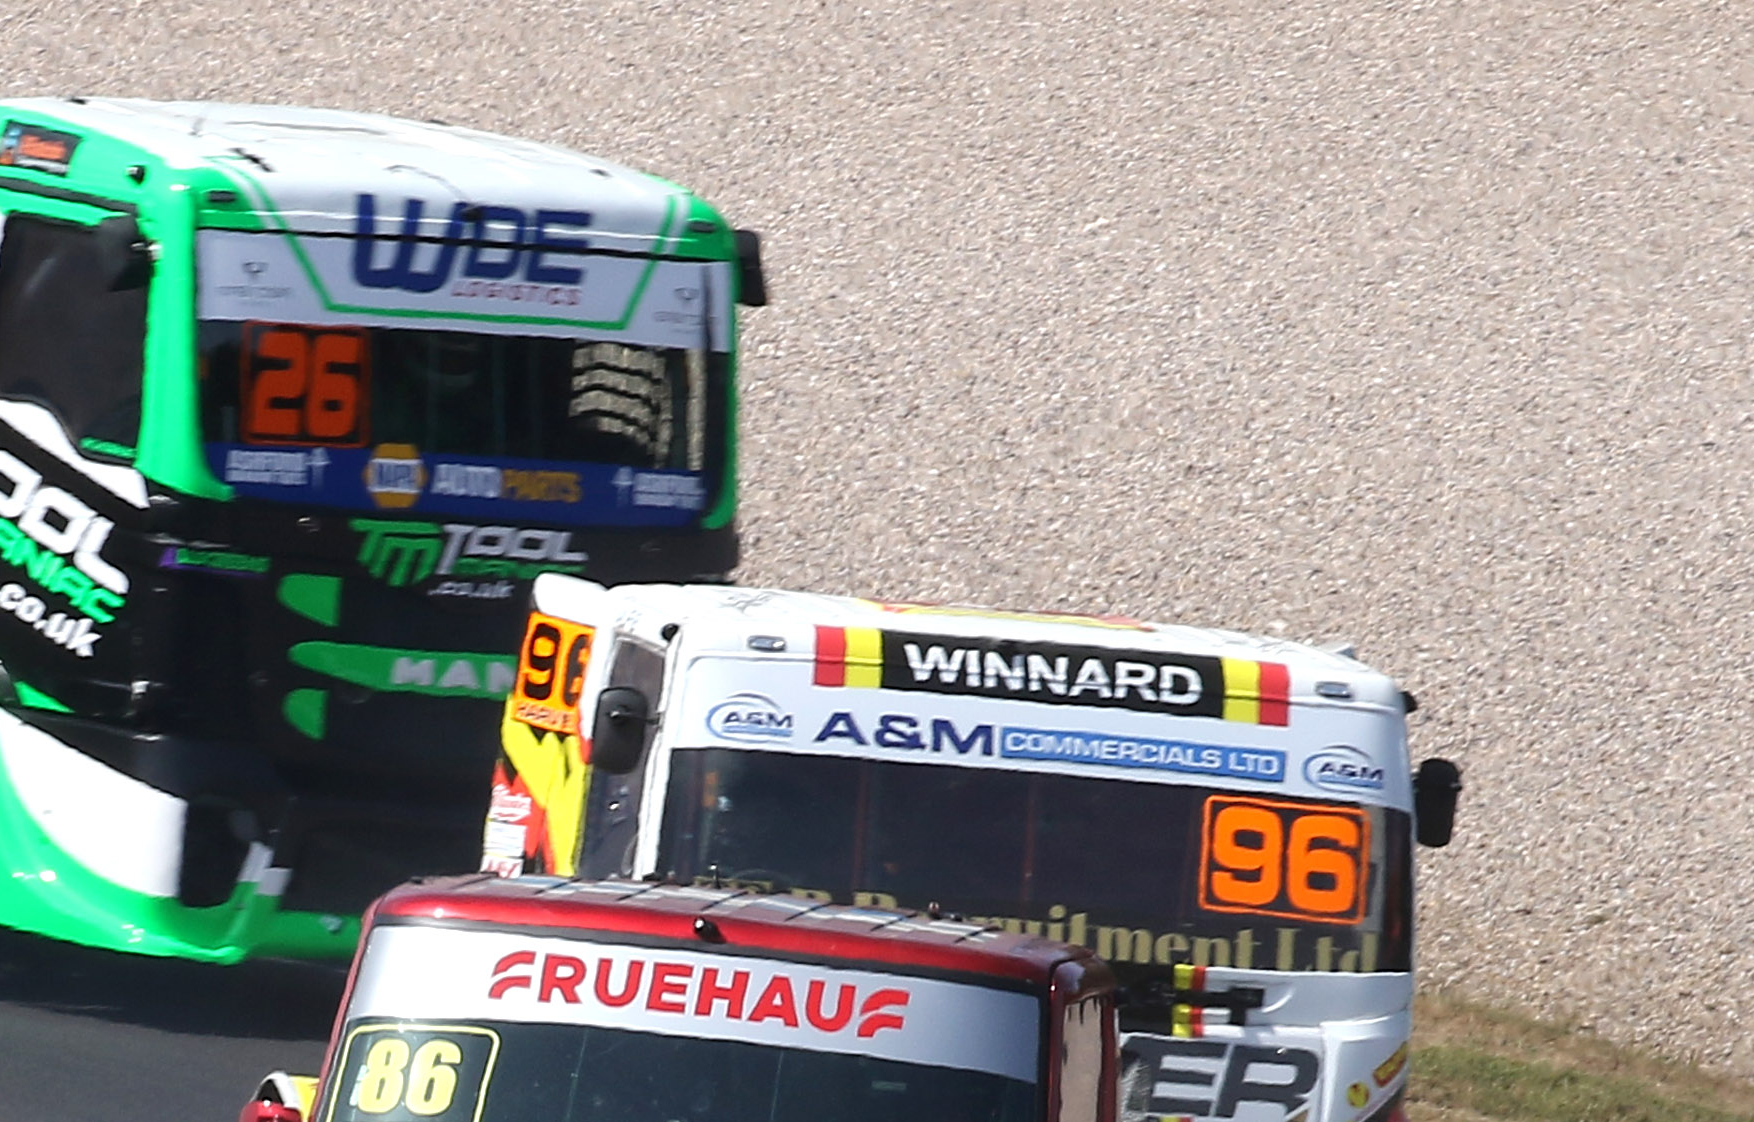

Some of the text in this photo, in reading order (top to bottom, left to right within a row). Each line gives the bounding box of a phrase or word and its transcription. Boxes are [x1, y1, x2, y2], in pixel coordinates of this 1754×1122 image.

[353, 193, 592, 294] WDE
[250, 330, 358, 438] 26
[436, 524, 589, 575] TOOL
[903, 642, 1203, 705] WINNARD
[721, 709, 792, 729] A&M
[813, 711, 1280, 776] A&M COMMERCIALS LTD
[1211, 805, 1360, 913] 96
[1276, 927, 1378, 972] Ltd
[488, 950, 911, 1038] FRUEHAUF
[356, 1037, 463, 1117] 86
[1123, 1036, 1321, 1119] ER
